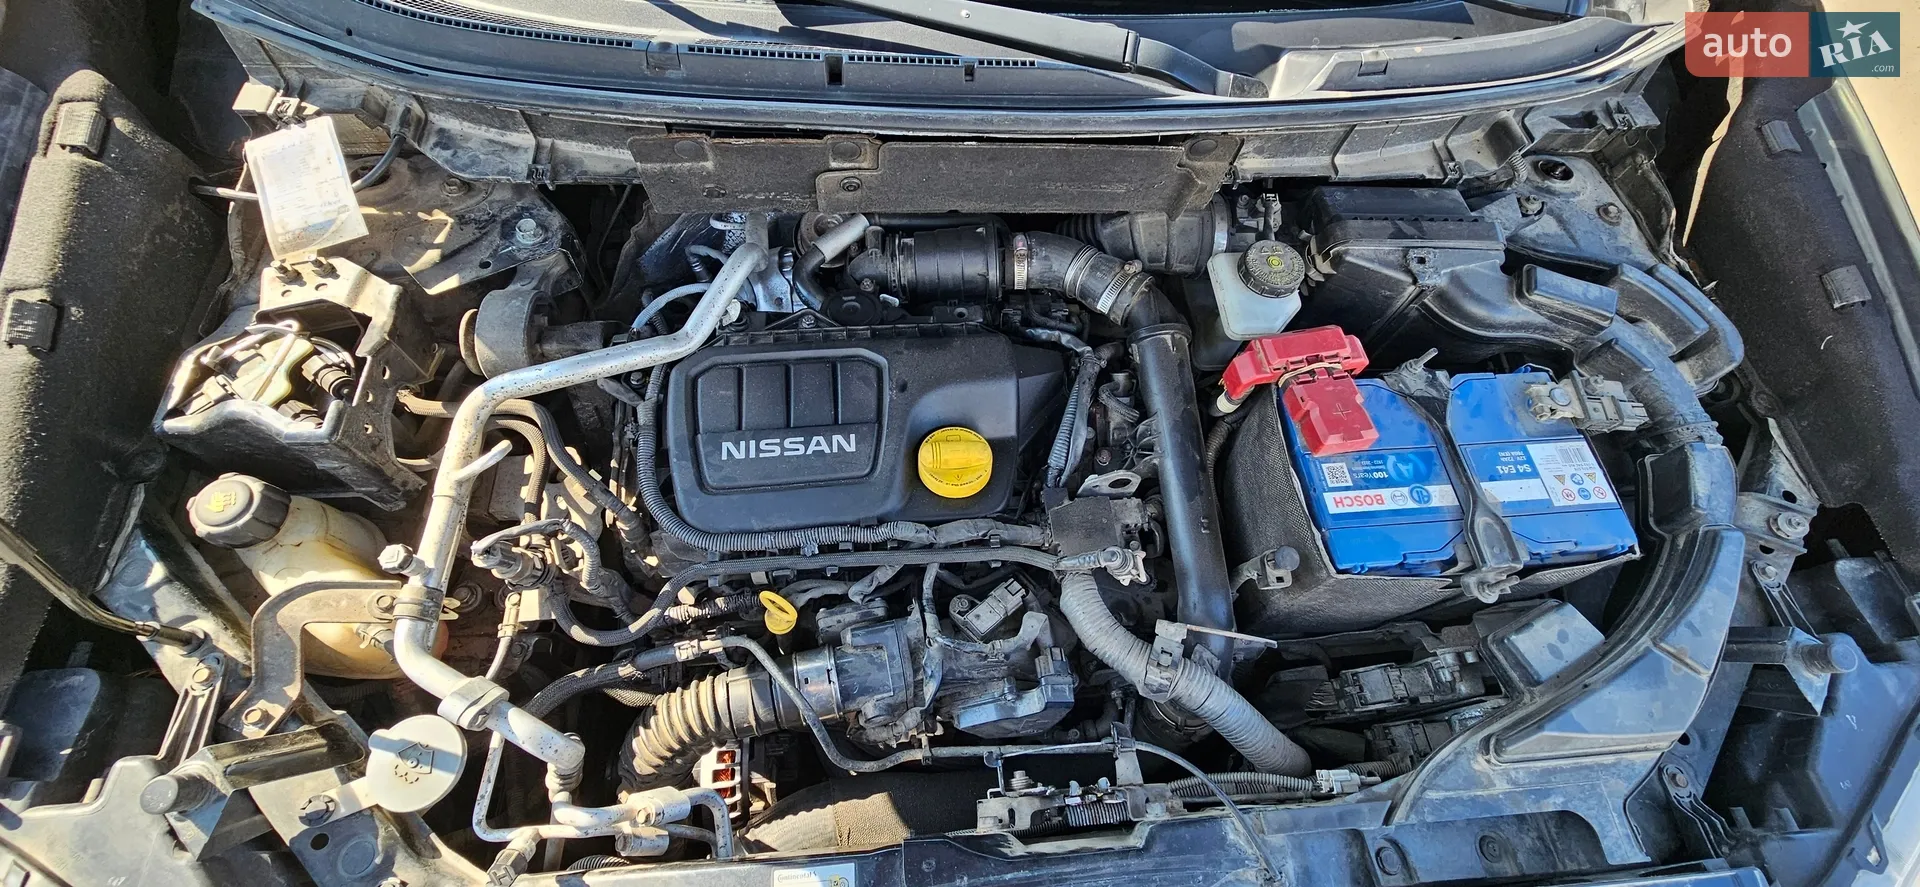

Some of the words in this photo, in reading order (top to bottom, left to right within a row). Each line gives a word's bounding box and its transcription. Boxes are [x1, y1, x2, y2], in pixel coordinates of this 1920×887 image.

[721, 433, 857, 461] NISSAN
[1496, 465, 1516, 474] E41
[1517, 464, 1532, 473] S4
[1333, 493, 1386, 508] BOSCH
